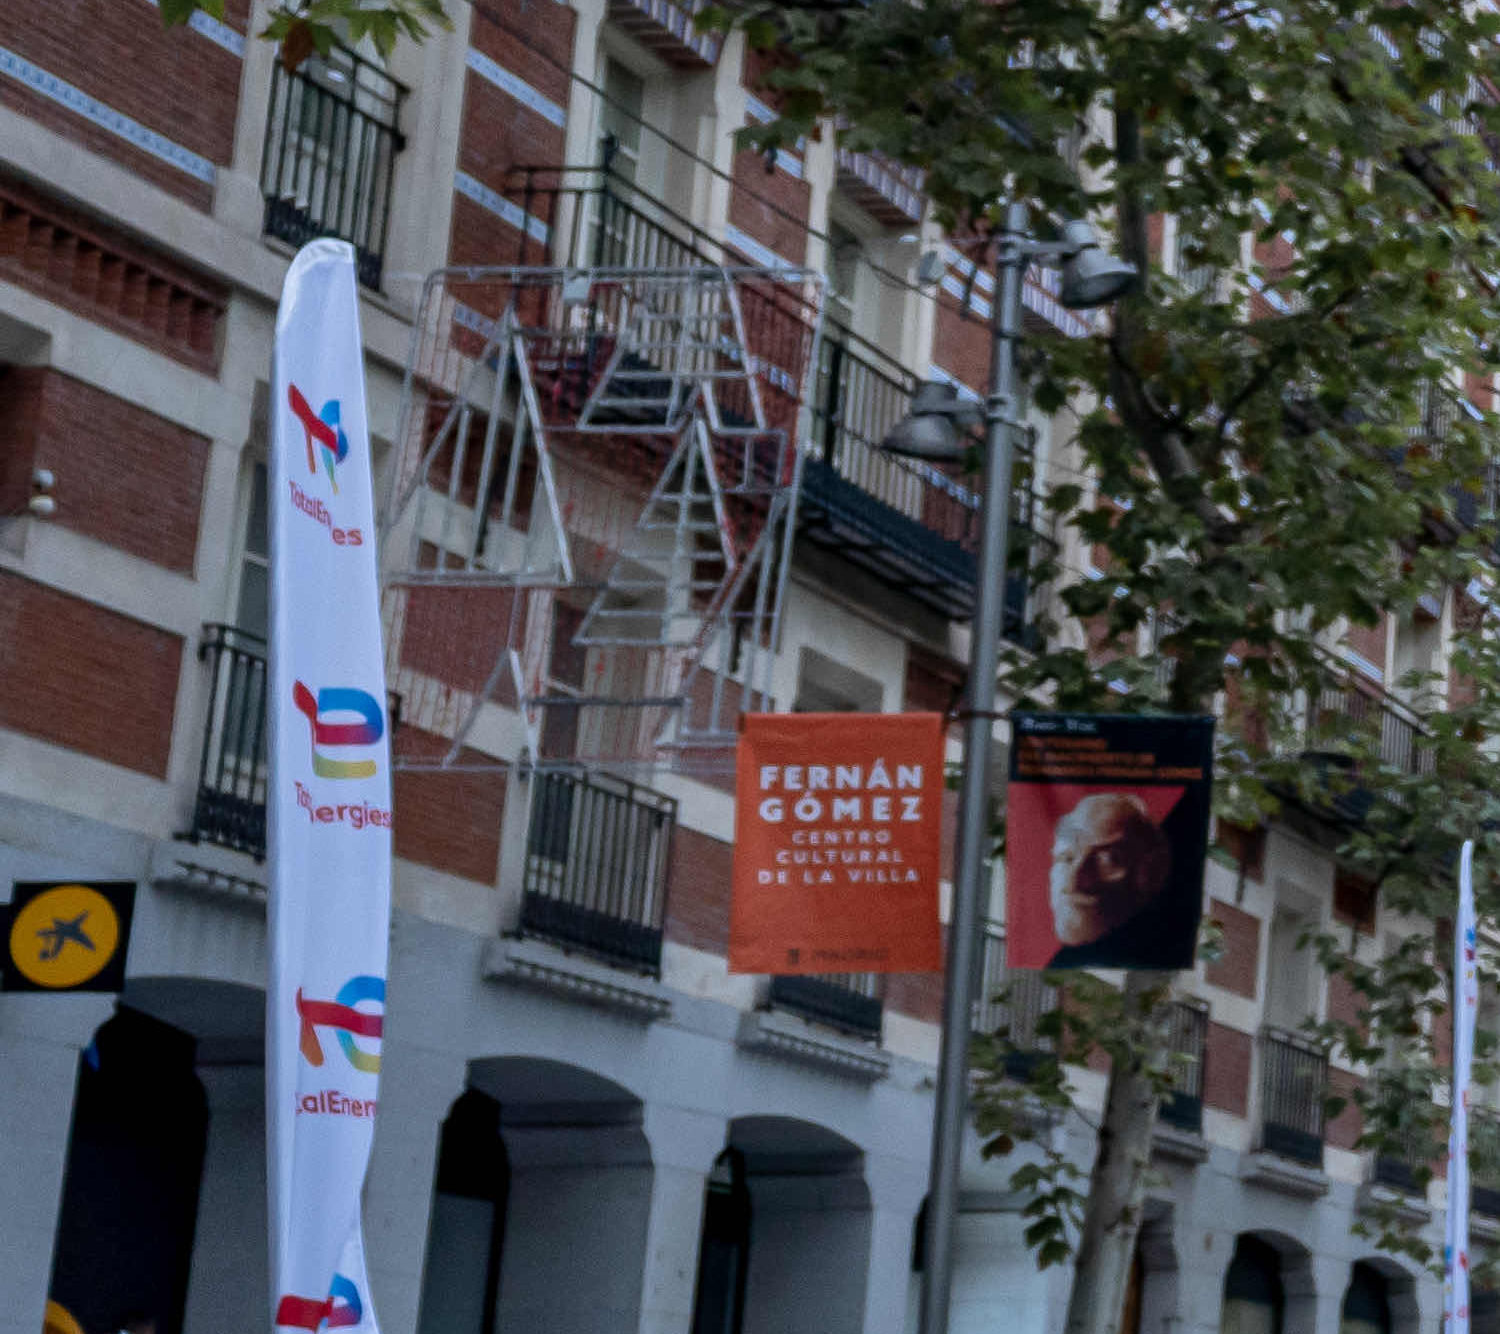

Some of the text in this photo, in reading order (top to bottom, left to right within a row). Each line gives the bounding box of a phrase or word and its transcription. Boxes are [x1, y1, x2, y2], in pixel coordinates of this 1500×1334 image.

[758, 758, 922, 789] FERNÁN
[759, 791, 921, 822] GÓMEZ
[792, 830, 890, 844] CENTRO
[776, 850, 903, 863] CULTURAL
[758, 869, 919, 884] DE LA VILLA
